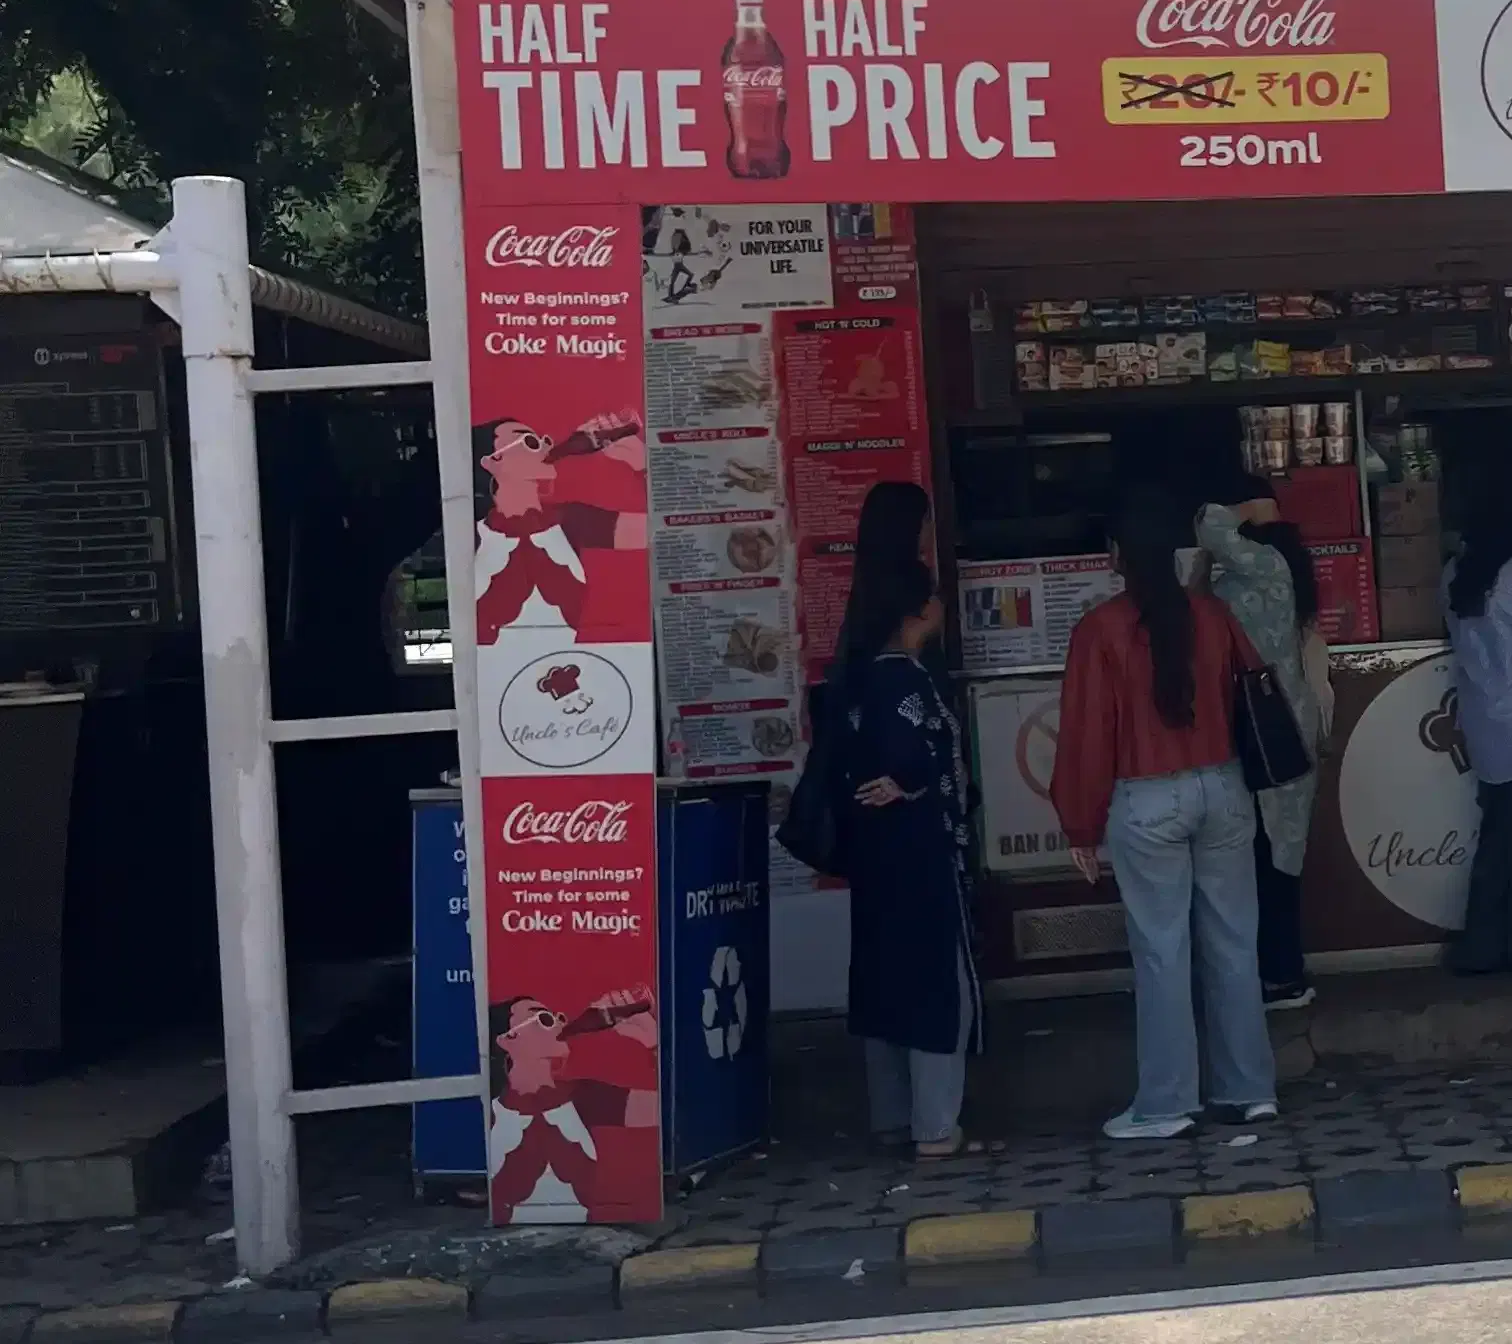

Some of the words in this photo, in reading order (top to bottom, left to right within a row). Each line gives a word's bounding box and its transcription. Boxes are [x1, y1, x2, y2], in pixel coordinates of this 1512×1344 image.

[479, 3, 609, 63] HALF
[483, 69, 708, 169] TIME
[808, 61, 1056, 161] PRICE
[1179, 132, 1322, 167] 250ml
[749, 220, 773, 235] FOR
[778, 219, 812, 233] YOUR
[486, 225, 620, 267] Coca-Cola
[481, 292, 520, 304] New
[524, 292, 629, 306] Beginnings?
[496, 313, 537, 325] Time
[542, 312, 566, 325] for
[571, 315, 616, 326] some
[485, 332, 547, 354] Coke
[556, 332, 627, 358] Magic
[503, 800, 635, 844] Coca-Cola
[998, 833, 1040, 855] BAN
[498, 870, 536, 883] New
[540, 867, 643, 884] Beginnings?
[512, 890, 553, 903] Time
[557, 889, 582, 902] for
[585, 890, 630, 902] some
[502, 909, 562, 932] Coke
[571, 907, 641, 936] Magic
